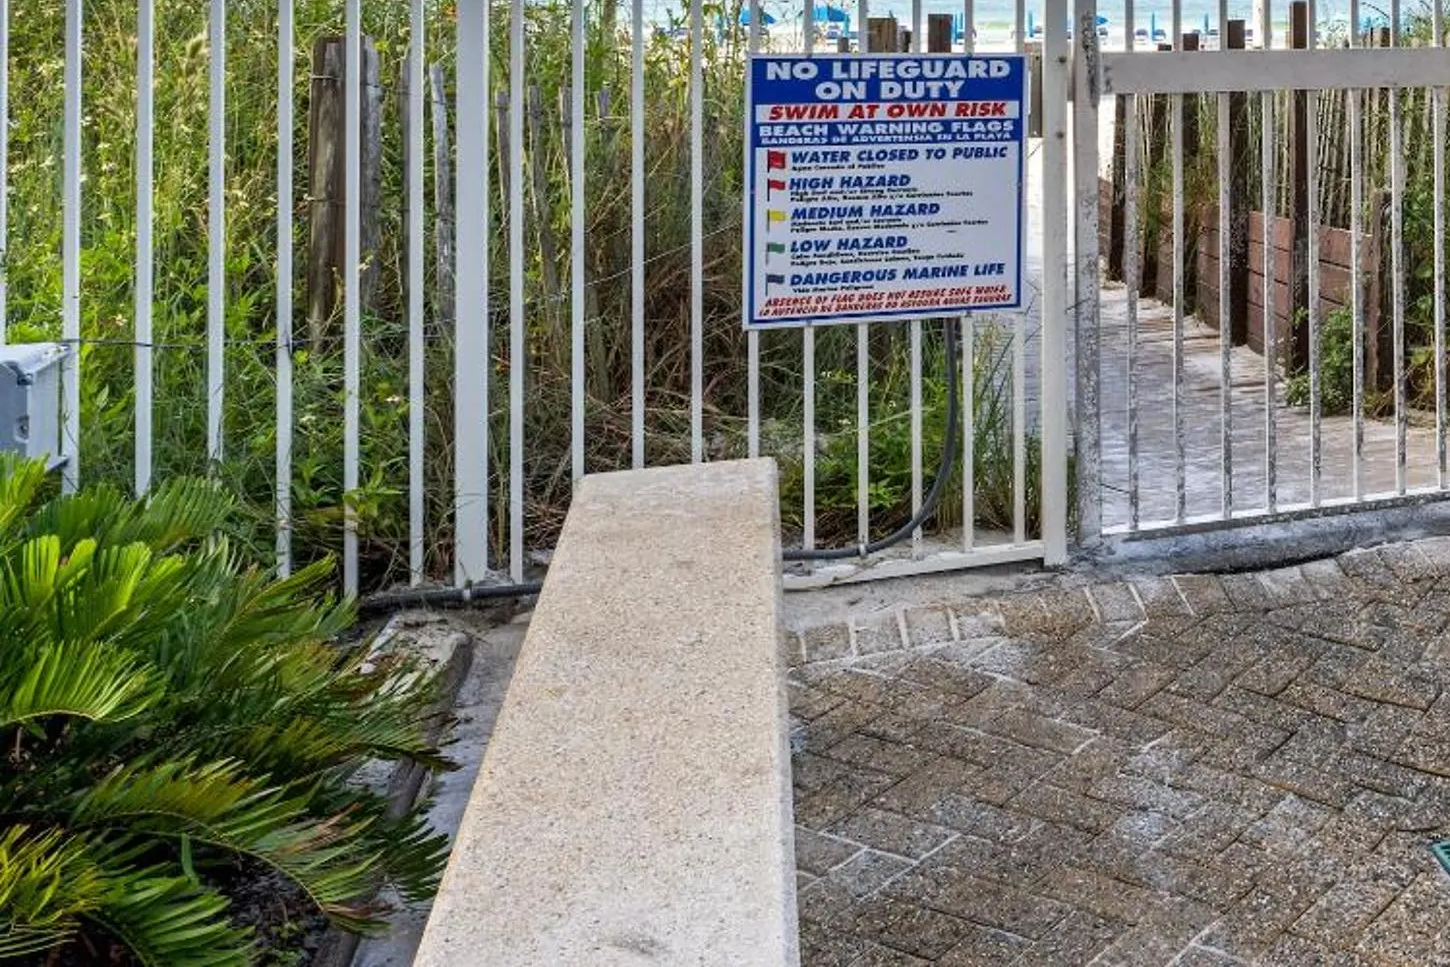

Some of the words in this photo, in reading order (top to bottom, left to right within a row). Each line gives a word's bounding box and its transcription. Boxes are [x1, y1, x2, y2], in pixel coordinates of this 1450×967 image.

[766, 61, 818, 80] NO
[832, 60, 1011, 79] LIFEGUARD
[815, 81, 866, 100] ON
[880, 81, 965, 99] DUTY
[769, 104, 844, 121] SWIM
[848, 103, 879, 119] AT
[887, 103, 947, 119] OWN
[954, 102, 1006, 117] RISK
[759, 124, 828, 137] BEACH
[837, 123, 944, 135] WARNING
[951, 120, 1014, 132] FLAGS
[973, 132, 1011, 140] PLAYA
[792, 150, 851, 164] WATER
[857, 148, 919, 162] CLOSED
[925, 148, 946, 160] TO
[952, 147, 1008, 160] PUBLIC
[789, 176, 834, 190] HIGH
[840, 174, 911, 188] HAZARD
[791, 206, 864, 221] MEDIUM
[869, 203, 941, 217] HAZARD
[790, 238, 831, 253] LOW
[836, 236, 908, 251] HAZARD
[790, 270, 897, 286] DANGEROUS
[902, 265, 969, 280] MARINE
[974, 263, 1006, 276] LIFE
[831, 294, 855, 303] FLAG
[858, 291, 886, 301] DOES
